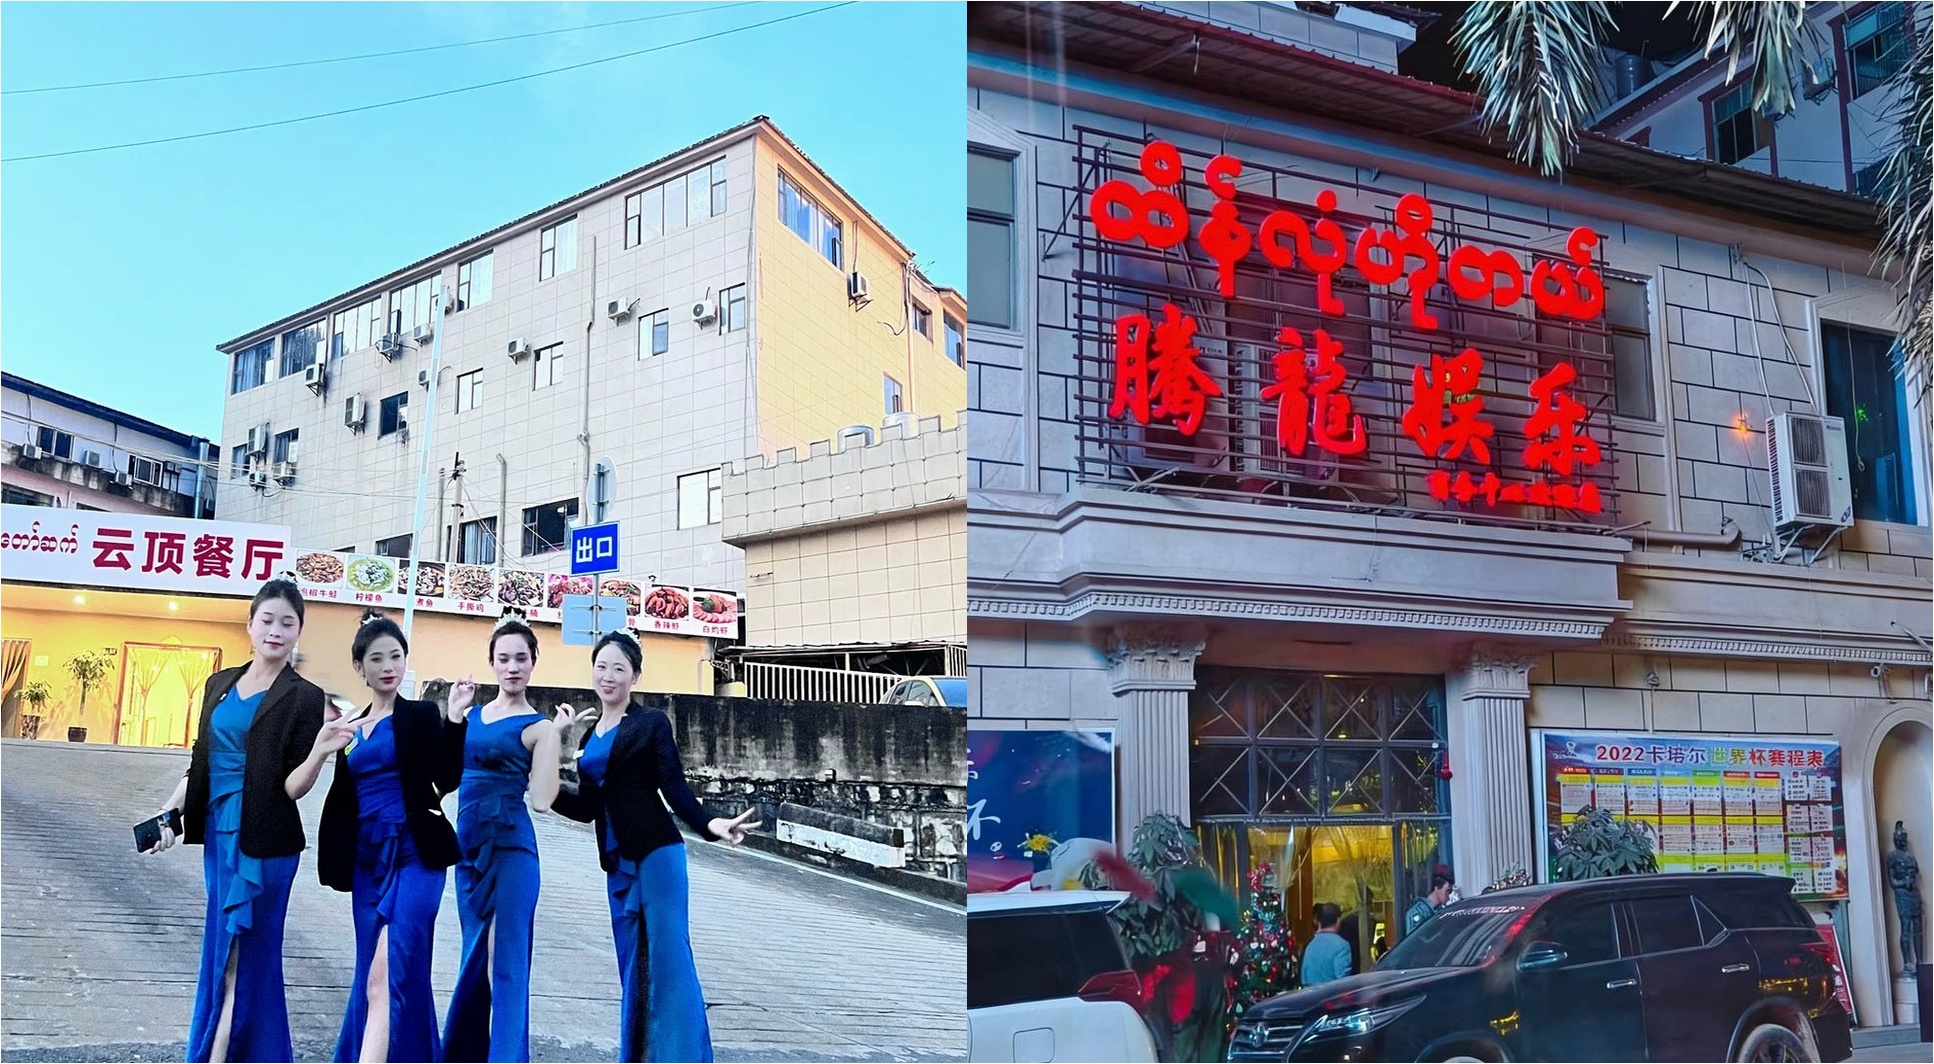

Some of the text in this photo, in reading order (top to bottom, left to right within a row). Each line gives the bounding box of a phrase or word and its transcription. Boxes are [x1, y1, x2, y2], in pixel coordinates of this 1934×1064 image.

[92, 527, 285, 581] 云顶餐厅
[575, 536, 613, 563] 出口
[654, 620, 680, 631] 香辣虾
[1596, 745, 1825, 768] 2022卡塔尔世界杯赛程表
